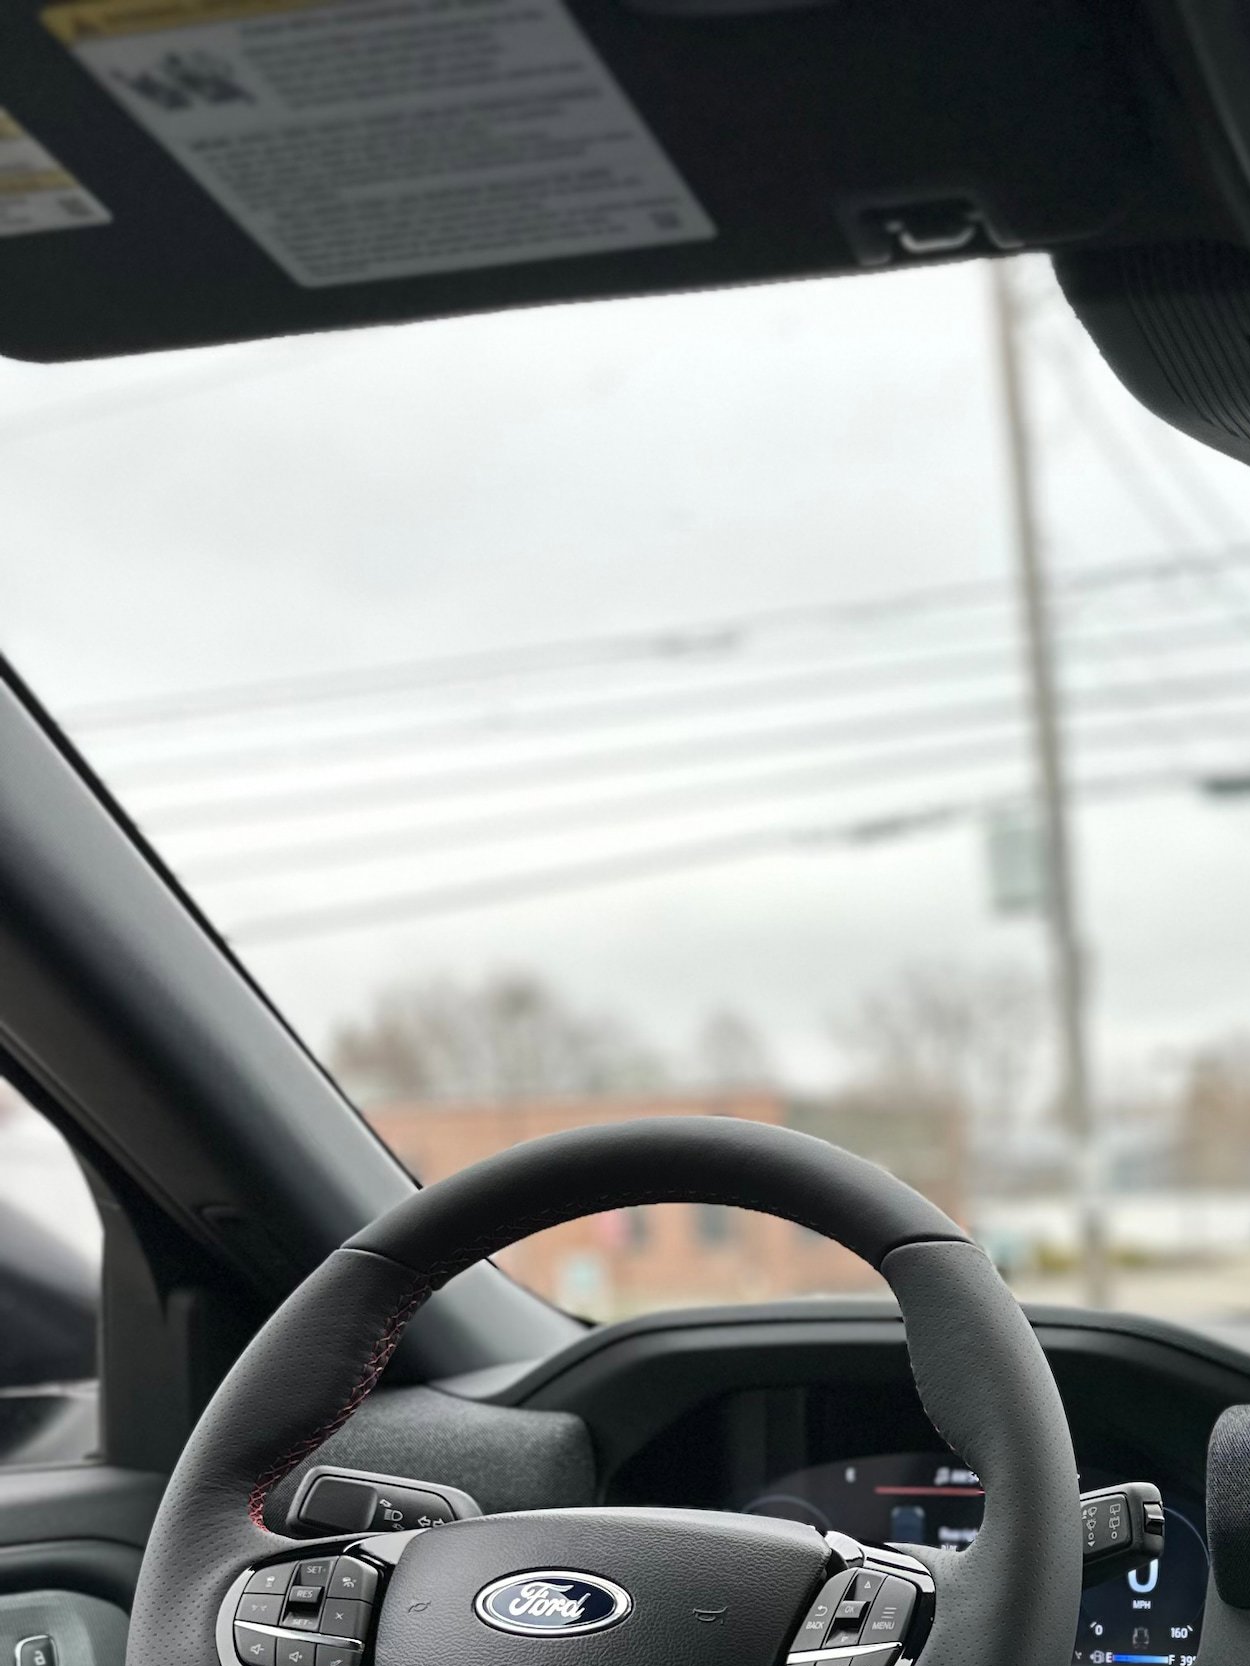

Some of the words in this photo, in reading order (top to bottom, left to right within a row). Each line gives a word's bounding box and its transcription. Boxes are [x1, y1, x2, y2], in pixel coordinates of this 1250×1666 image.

[296, 1590, 313, 1598] RES
[509, 1581, 592, 1618] Ford
[1132, 1600, 1152, 1610] MPH
[805, 1621, 825, 1630] BACK
[871, 1621, 895, 1630] MENU
[1094, 1624, 1104, 1636] 0
[1170, 1627, 1189, 1639] 160
[1105, 1651, 1113, 1663] E
[1168, 1654, 1176, 1666] F
